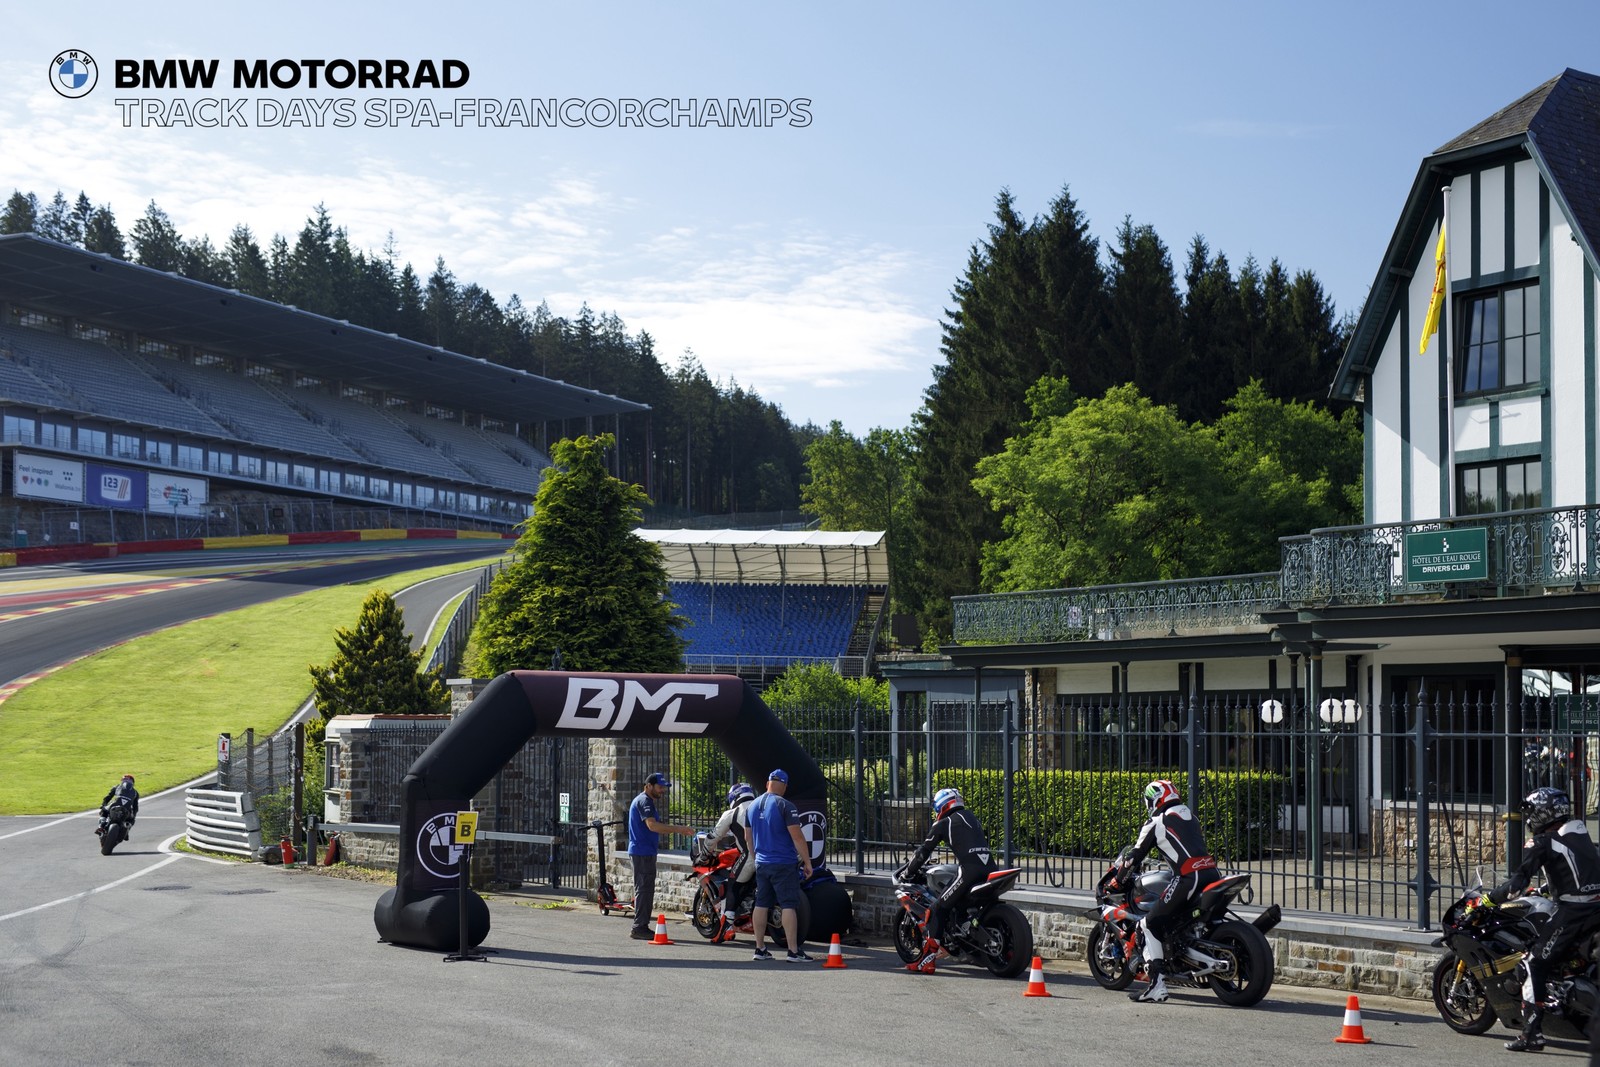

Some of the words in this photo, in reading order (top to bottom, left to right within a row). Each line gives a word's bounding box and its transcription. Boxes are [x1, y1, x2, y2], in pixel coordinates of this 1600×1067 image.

[104, 476, 118, 489] 123
[1412, 556, 1431, 565] HÔTEL
[1433, 556, 1441, 564] DE
[1459, 553, 1480, 561] ROUGE
[1422, 565, 1450, 573] DRIVERS
[1451, 563, 1470, 571] CLUB
[555, 677, 719, 733] BMC
[461, 825, 471, 837] B
